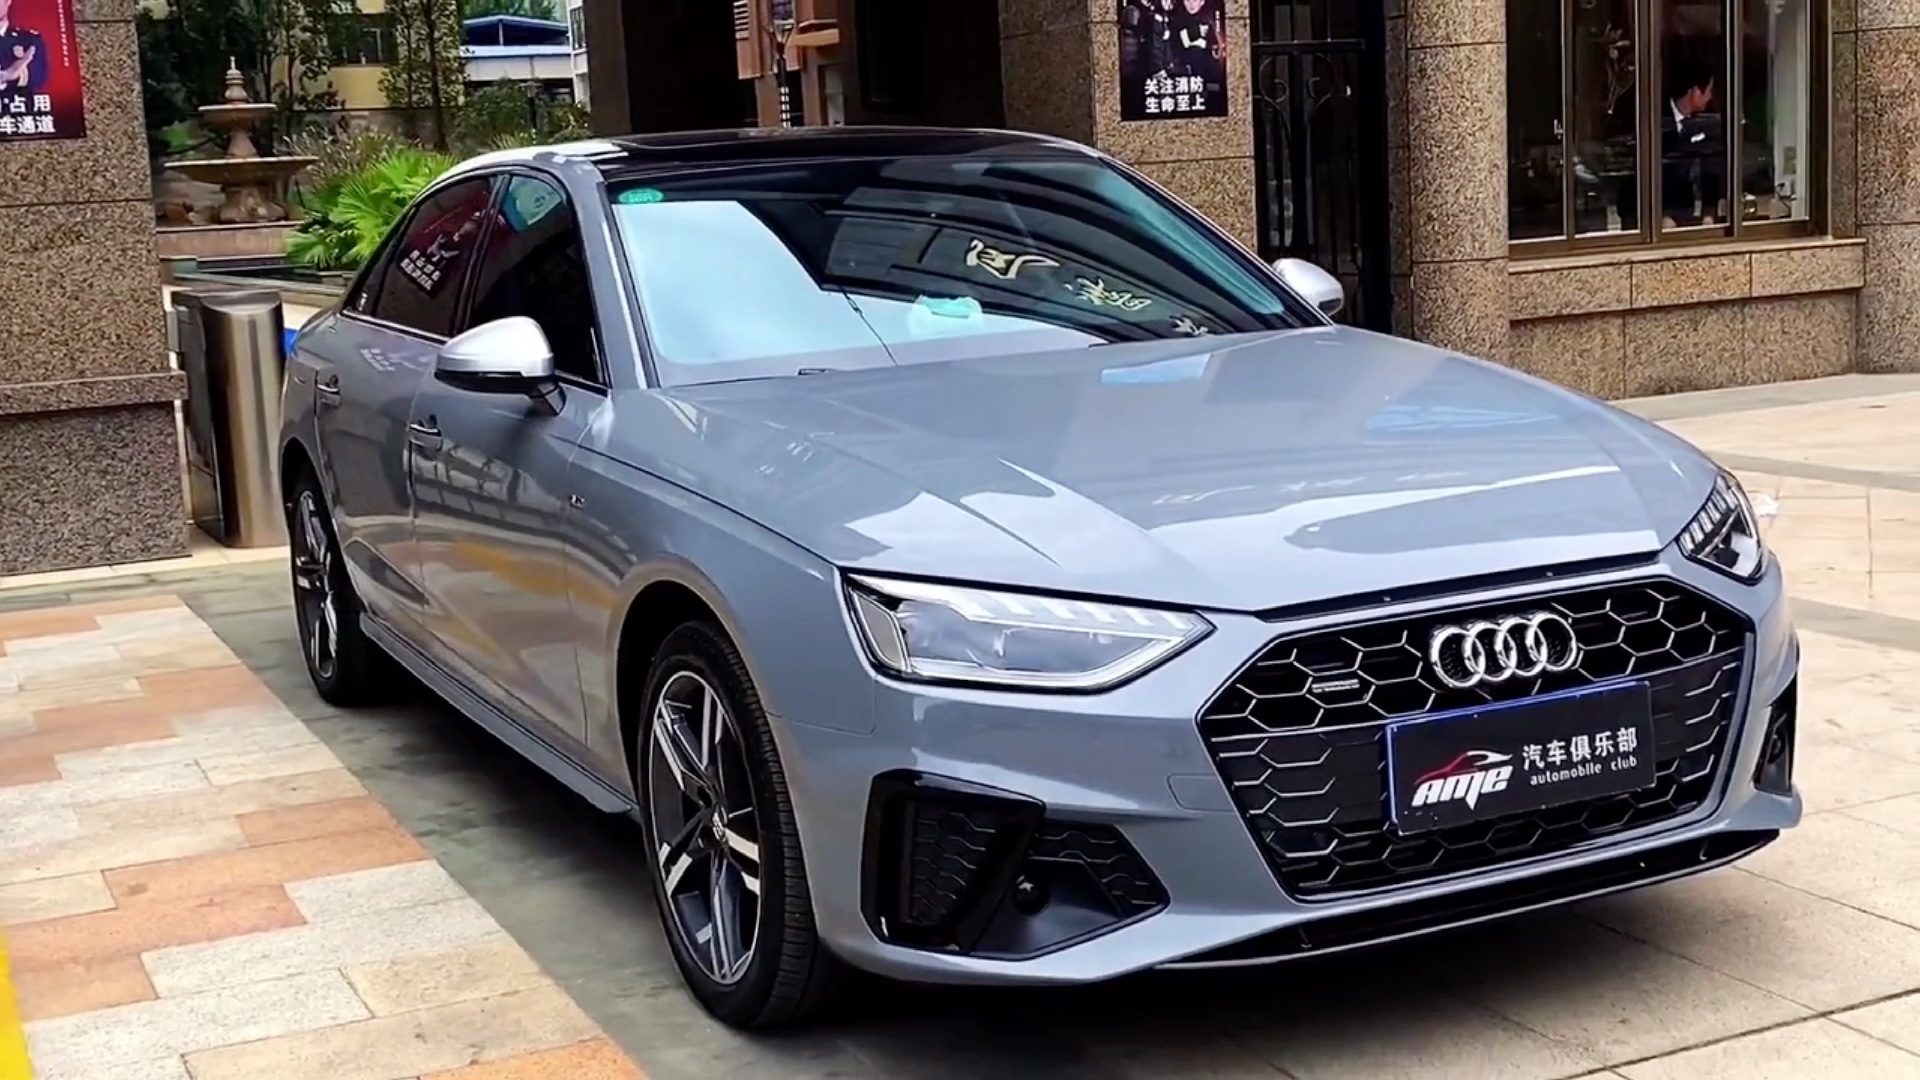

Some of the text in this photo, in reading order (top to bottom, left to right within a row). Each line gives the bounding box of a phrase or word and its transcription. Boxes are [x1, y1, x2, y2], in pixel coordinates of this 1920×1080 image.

[1144, 75, 1204, 95] 关注消防
[0, 94, 51, 113] 占用
[1145, 94, 1206, 113] 生命至上
[0, 115, 56, 134] 车通道
[1522, 727, 1638, 771] 汽车俱乐部
[1530, 755, 1638, 786] automobile club
